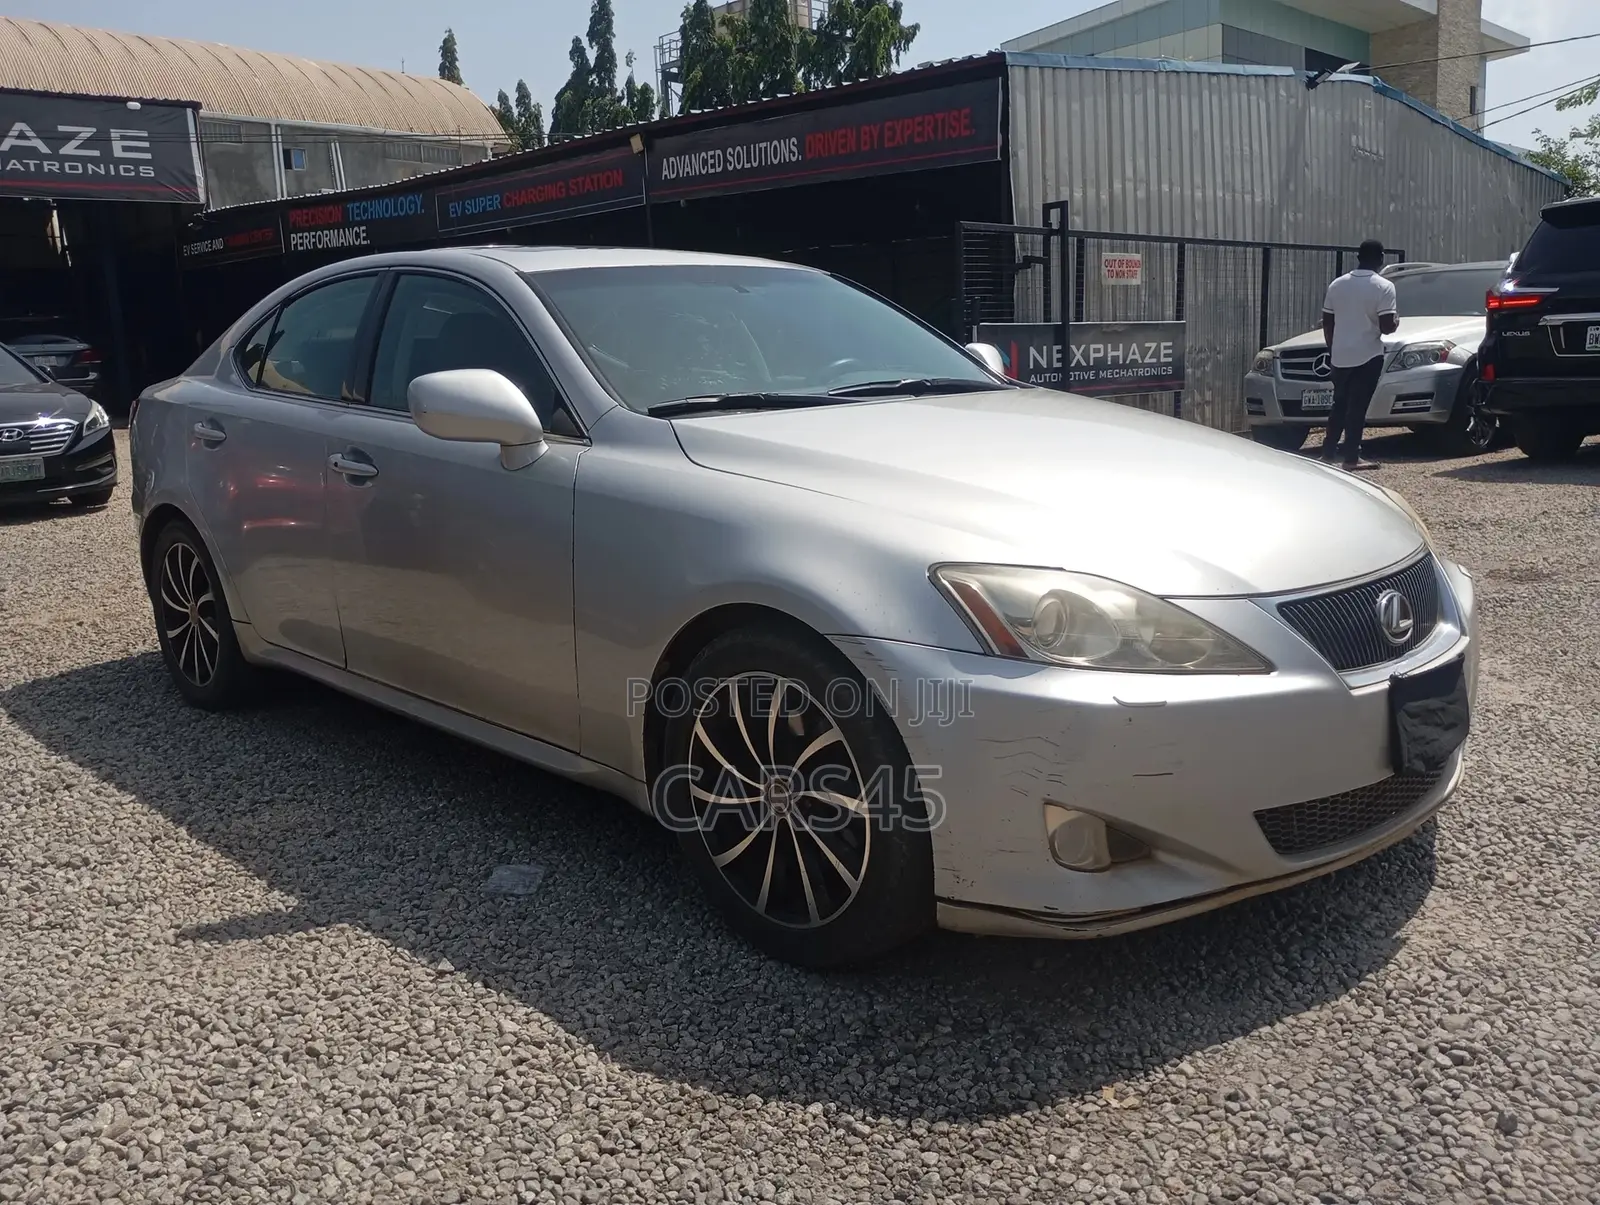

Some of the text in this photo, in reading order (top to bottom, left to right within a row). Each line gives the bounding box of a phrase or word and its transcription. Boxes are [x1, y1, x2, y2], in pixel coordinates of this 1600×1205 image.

[0, 122, 152, 159] AZE
[662, 108, 975, 180] ADVANCED SOLUTIONS. DRIVEN BY EXPERTISE.
[0, 159, 155, 177] ATRONICS
[449, 169, 624, 218] EV SUPER CHARGING STATION
[289, 194, 424, 228] PRECISION TECHNOLOGY.
[183, 245, 190, 256] EV
[191, 240, 211, 255] SERVICE
[212, 238, 224, 250] AND
[290, 226, 371, 251] PERFORMANCE.
[1104, 259, 1117, 269] OUT
[1117, 259, 1125, 269] OF
[1107, 269, 1115, 279] TO
[1115, 269, 1126, 279] NON
[1029, 342, 1173, 369] NEXPHAZE
[1099, 366, 1173, 378] MECHATRONICS
